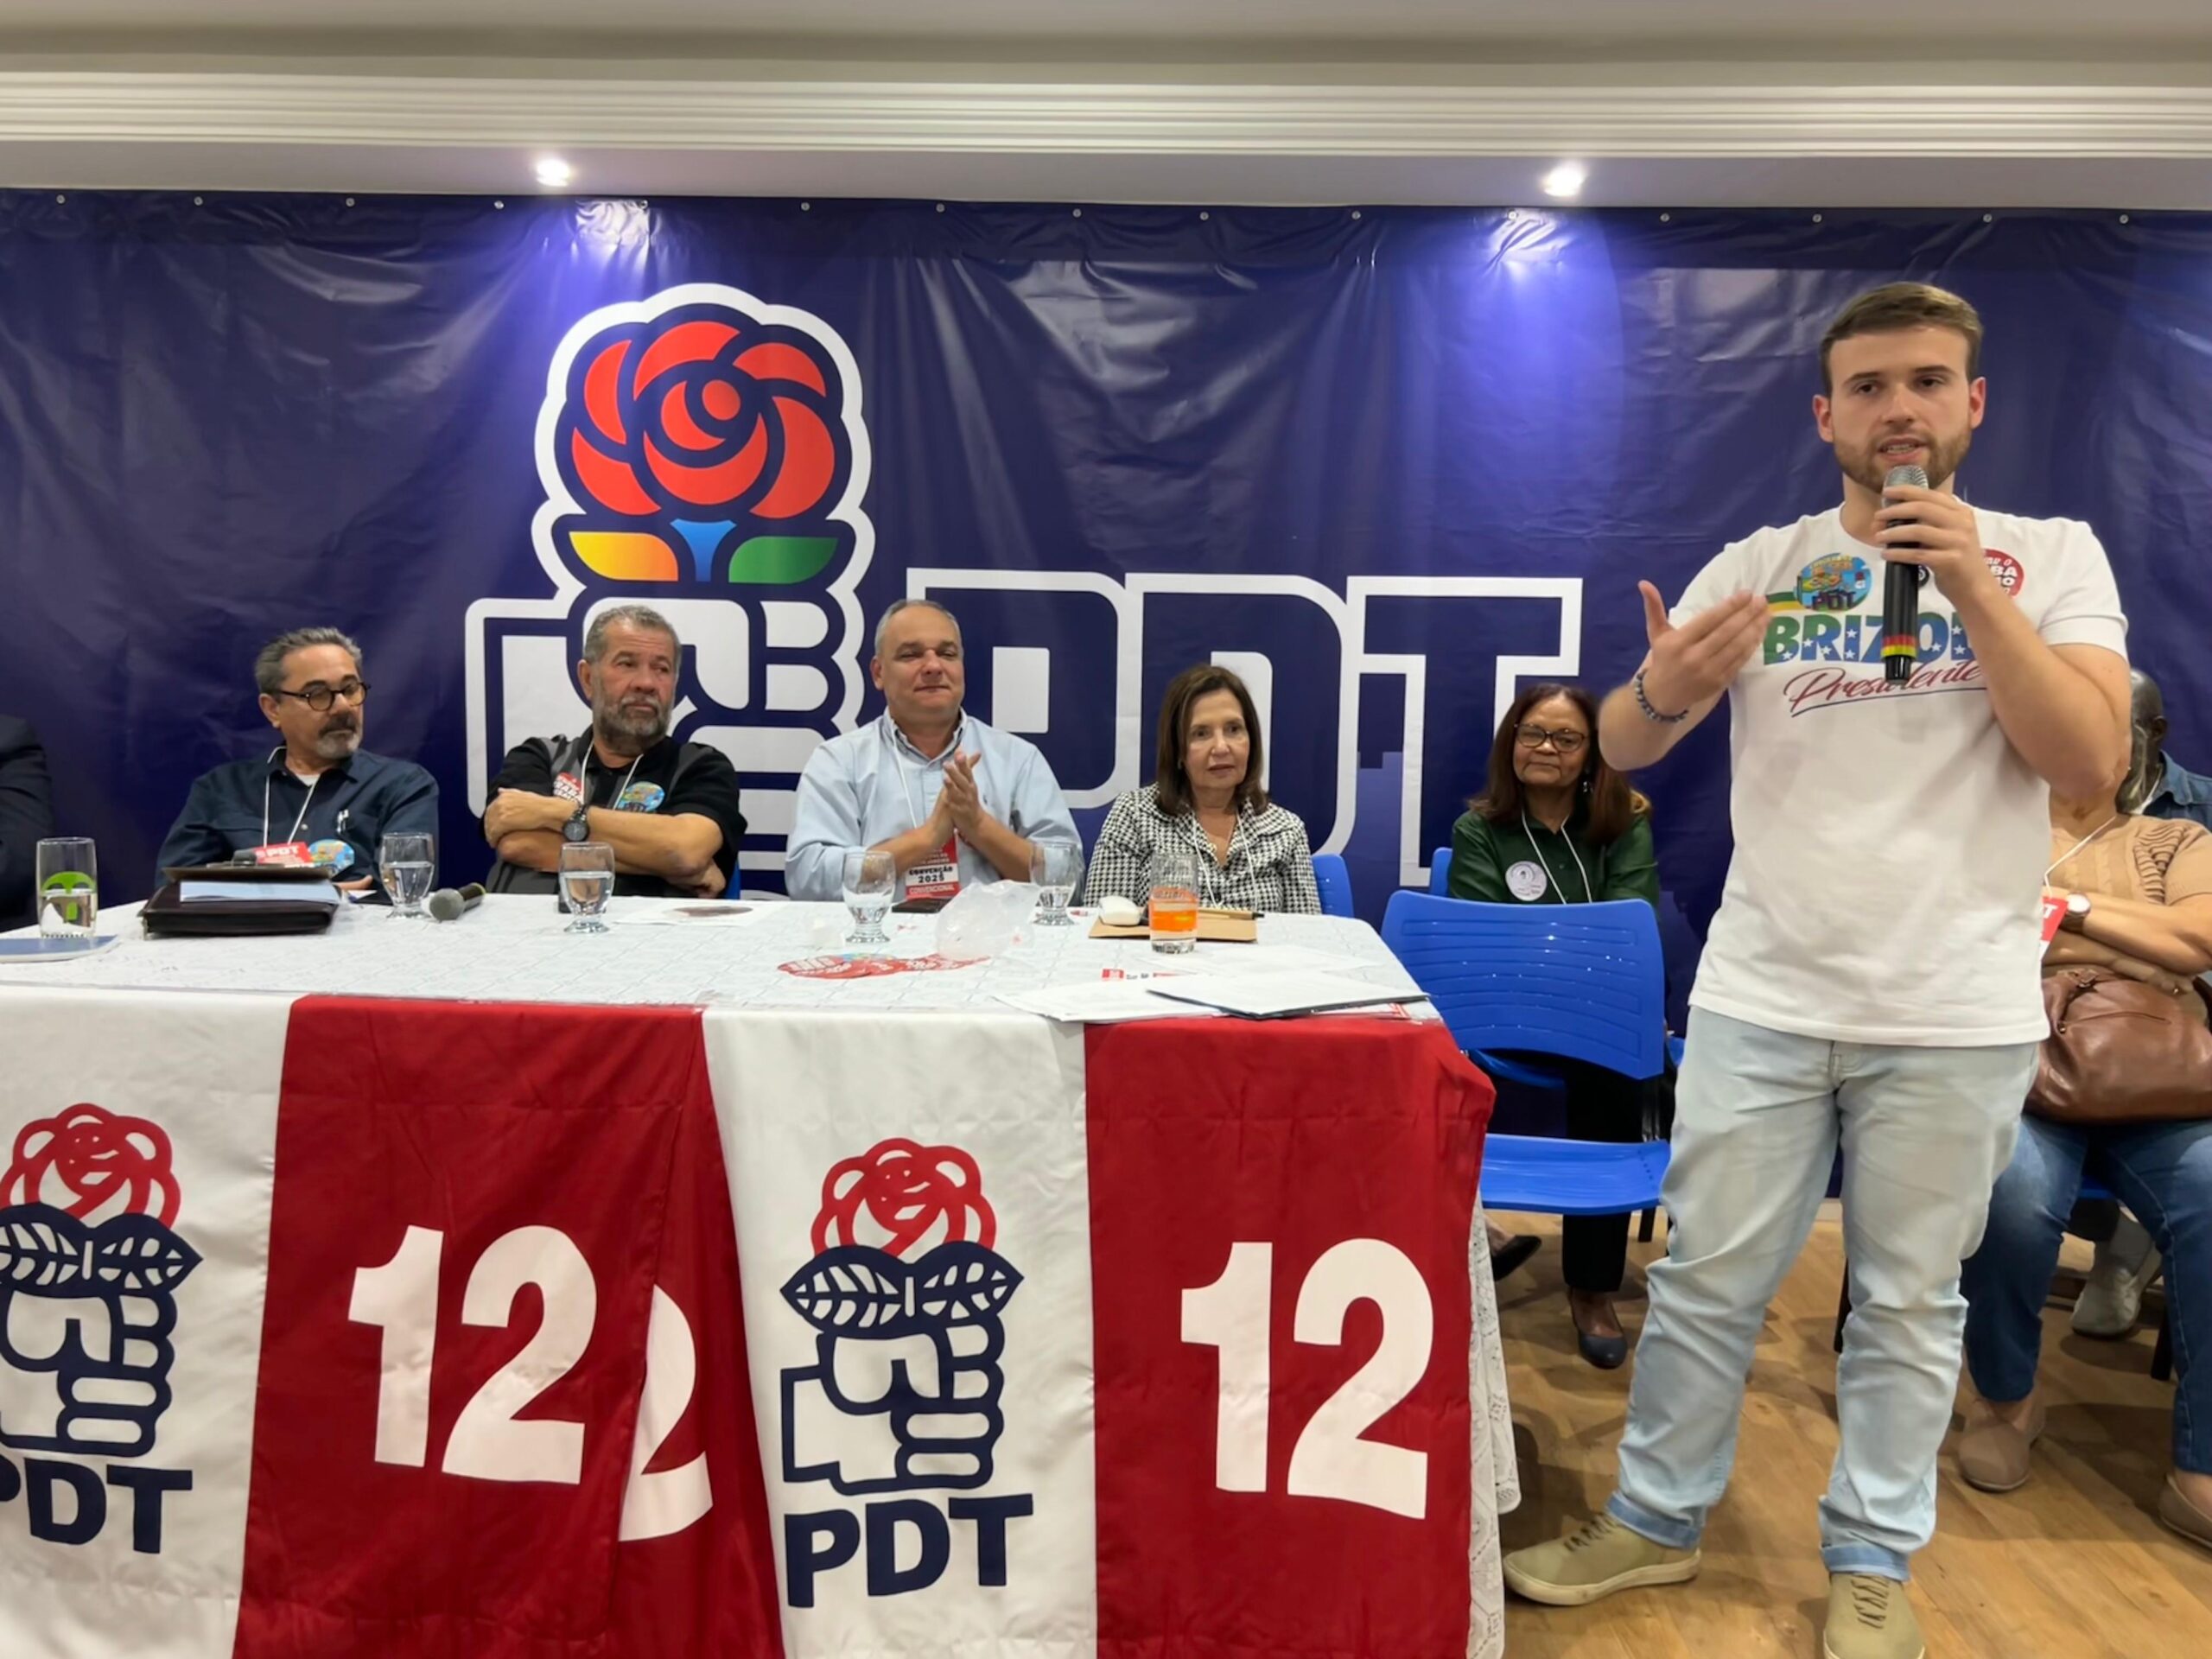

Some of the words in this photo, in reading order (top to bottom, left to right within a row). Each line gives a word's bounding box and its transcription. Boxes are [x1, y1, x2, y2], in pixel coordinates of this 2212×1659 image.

[906, 568, 1582, 887] PDT
[1764, 612, 1976, 665] BRIZOL
[918, 874, 944, 883] 2025
[347, 1224, 597, 1484] 12
[619, 1283, 714, 1541] 2
[1180, 1238, 1433, 1520] 12
[784, 1493, 1033, 1609] PDT
